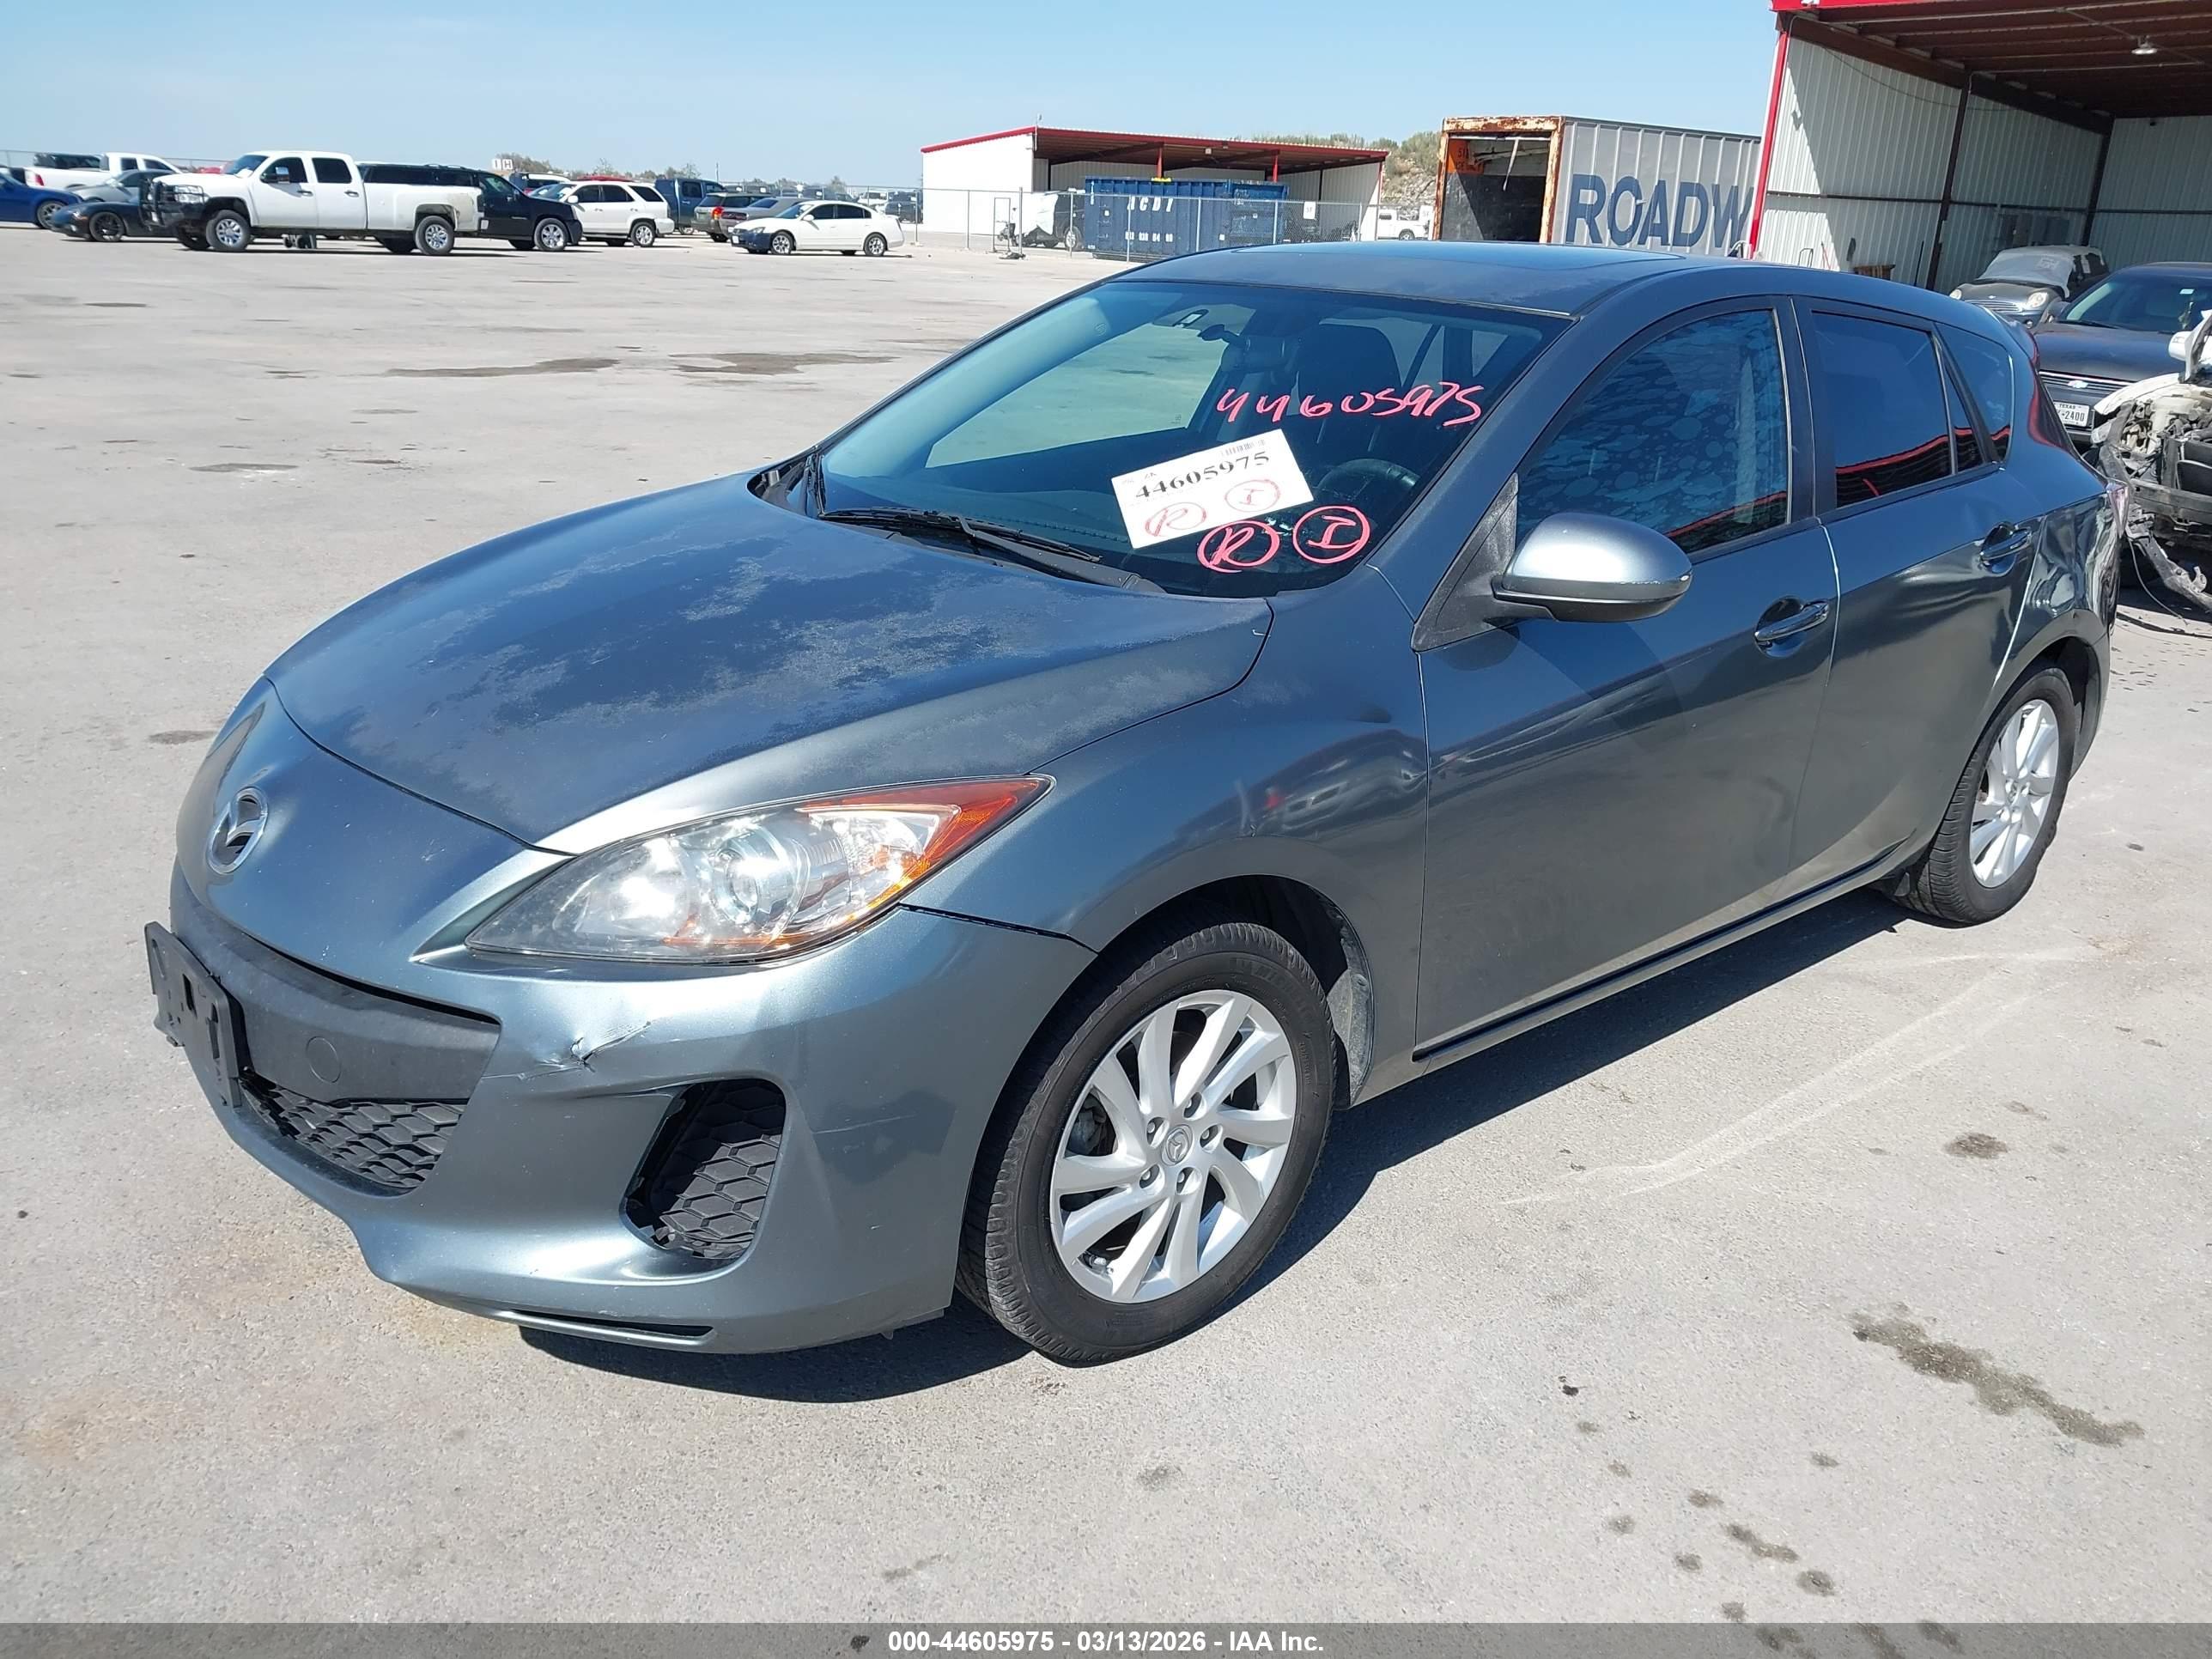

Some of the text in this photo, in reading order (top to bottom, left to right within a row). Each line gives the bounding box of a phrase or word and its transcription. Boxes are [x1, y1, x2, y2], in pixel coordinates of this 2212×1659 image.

[1566, 173, 1754, 248] ROADW
[1217, 381, 1484, 426] 44605975
[1136, 451, 1269, 498] 44605975
